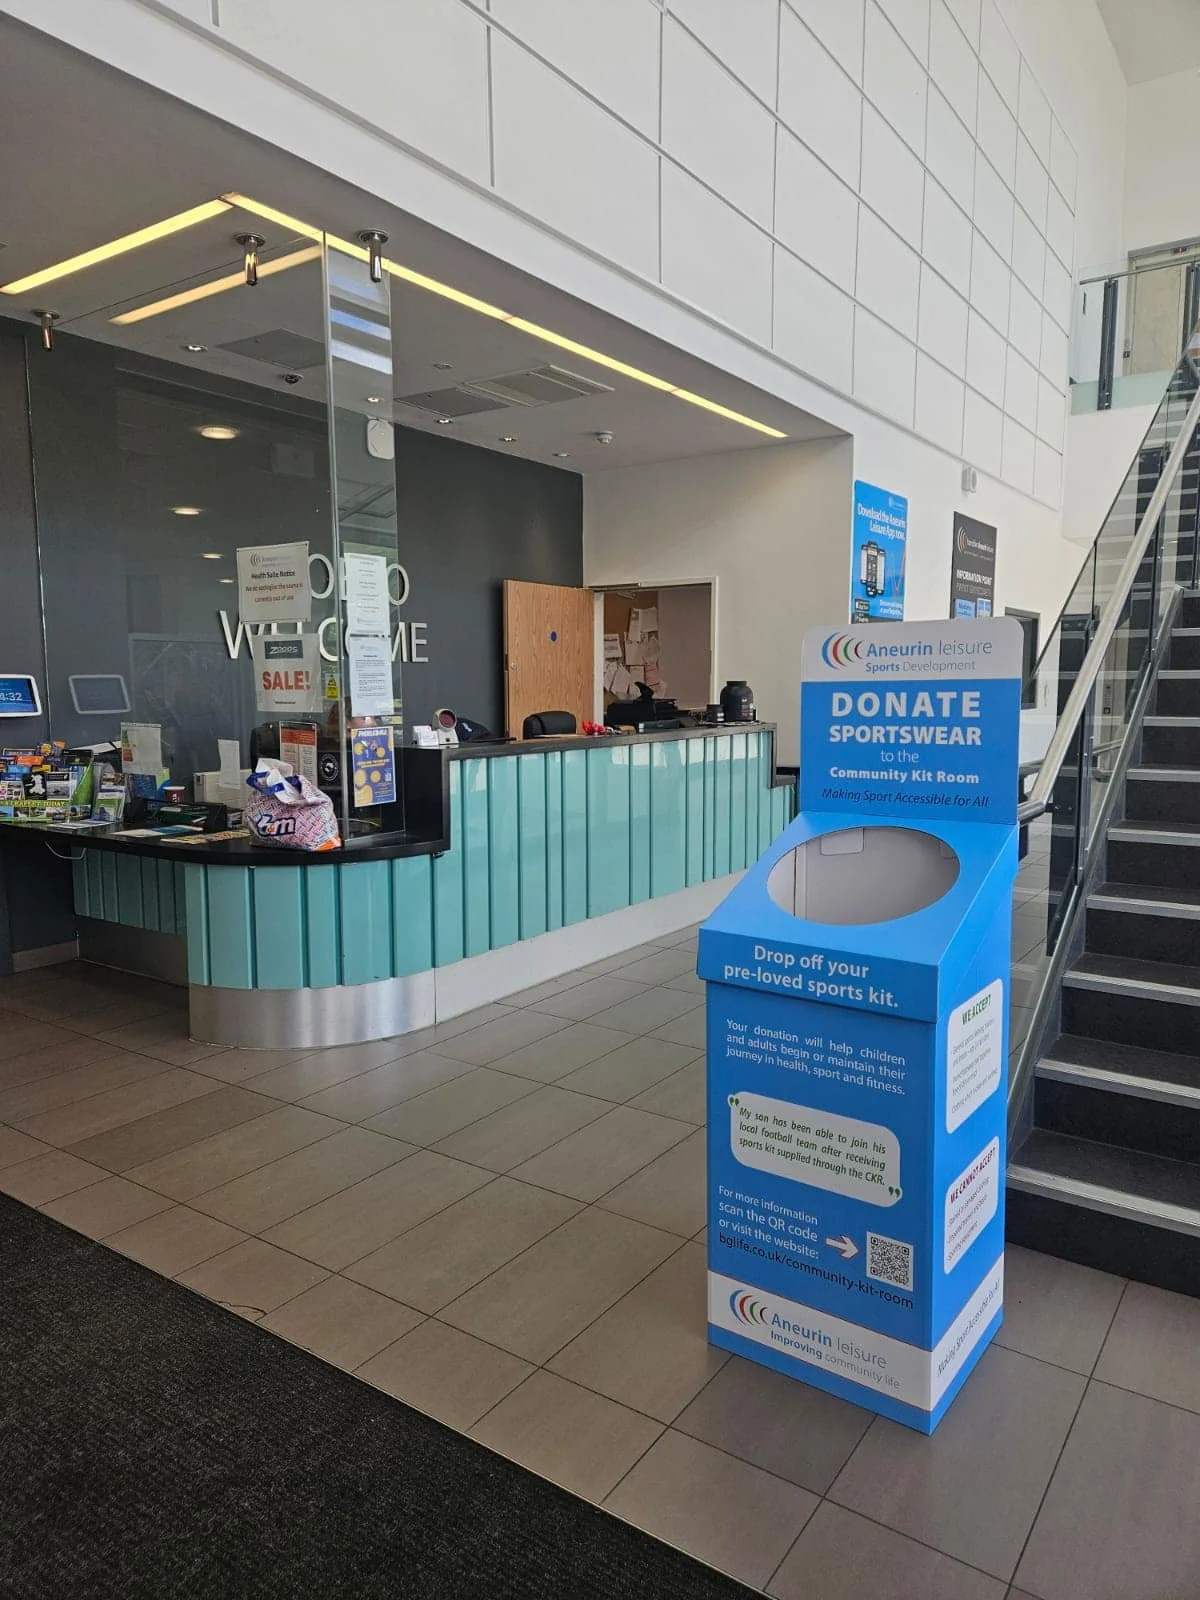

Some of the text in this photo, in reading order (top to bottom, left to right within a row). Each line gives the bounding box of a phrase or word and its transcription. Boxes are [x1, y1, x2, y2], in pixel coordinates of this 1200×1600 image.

[219, 610, 429, 663] WCME
[866, 639, 993, 658] Aneurin leisure
[262, 670, 311, 691] SALE!
[865, 660, 975, 674] Sports Development
[831, 691, 981, 718] DONATE
[829, 725, 982, 746] SPORTSWEAR
[830, 766, 979, 784] Community Kit Room
[880, 750, 920, 763] to the
[822, 788, 989, 808] Making Sport Accessible for All
[754, 945, 869, 979] Drop off your
[724, 964, 899, 1008] pre-loved sports kit.
[726, 1018, 905, 1066] Your donation will help children
[726, 1033, 905, 1081] and adults begin or maintain their
[726, 1047, 905, 1095] journey in health, sport and fitness.
[739, 1107, 886, 1155] My son has been able to join his
[739, 1122, 886, 1172] local football team after receiving
[739, 1137, 885, 1186] sports kit supplied through the CKR.
[719, 1185, 818, 1225] For more information
[719, 1202, 818, 1242] scan the QR code
[719, 1219, 819, 1260] or visit the website:
[719, 1232, 914, 1310] bglife.co.uk/community-kit-room
[770, 1330, 900, 1390] Improving community life
[771, 1313, 888, 1369] Aneurin leisure
